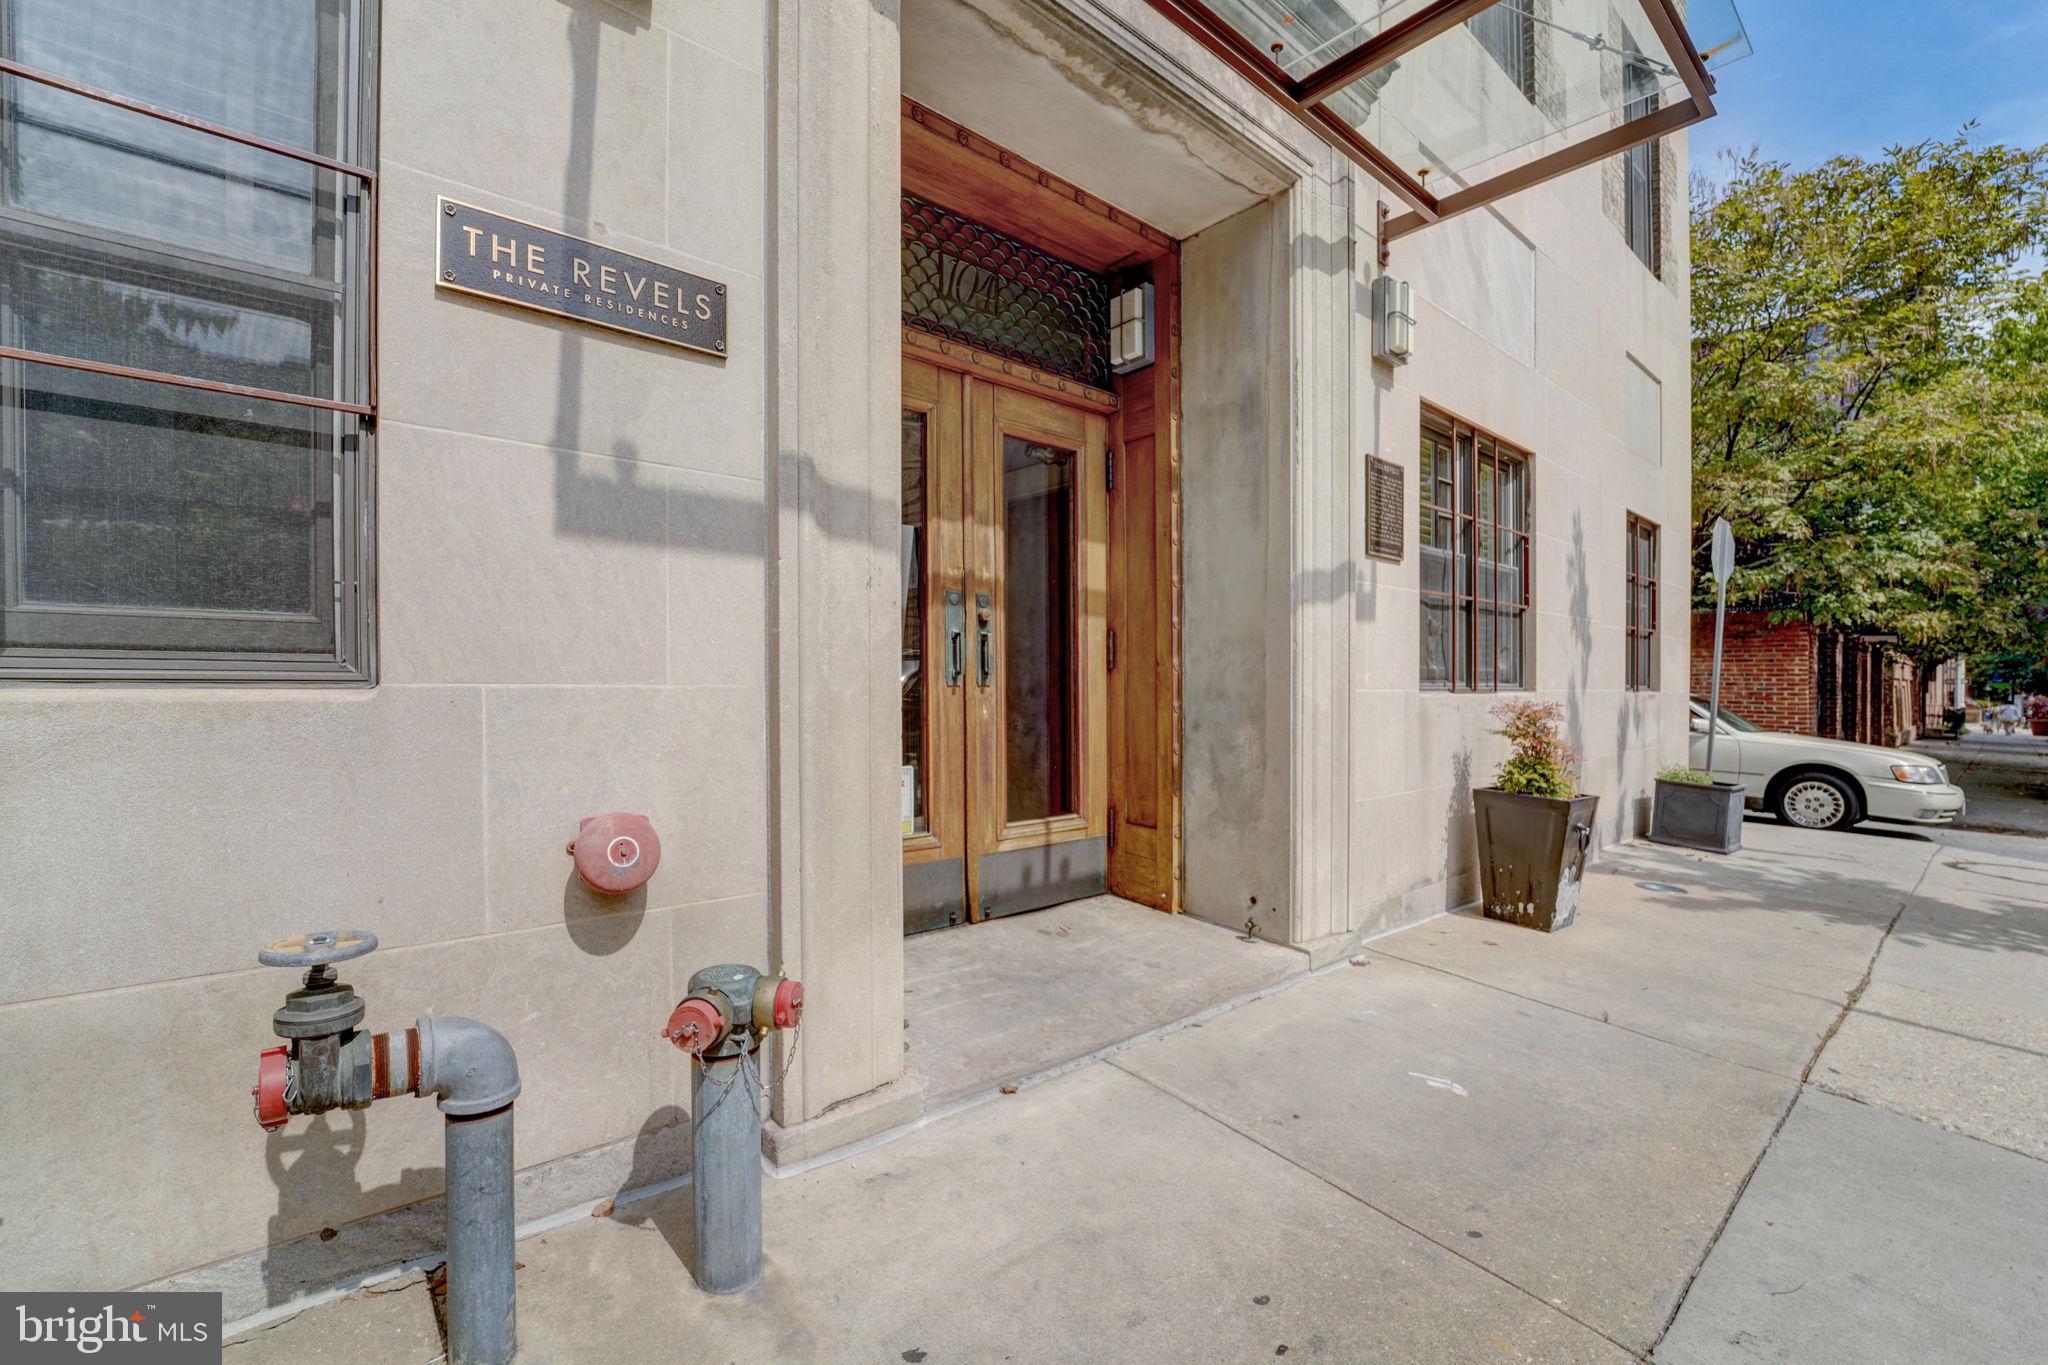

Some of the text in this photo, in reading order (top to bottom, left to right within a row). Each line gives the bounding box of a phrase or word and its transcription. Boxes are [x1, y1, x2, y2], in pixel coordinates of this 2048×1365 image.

[462, 226, 712, 321] THE REVELS
[493, 270, 689, 330] PRIVATE RESIDENCES
